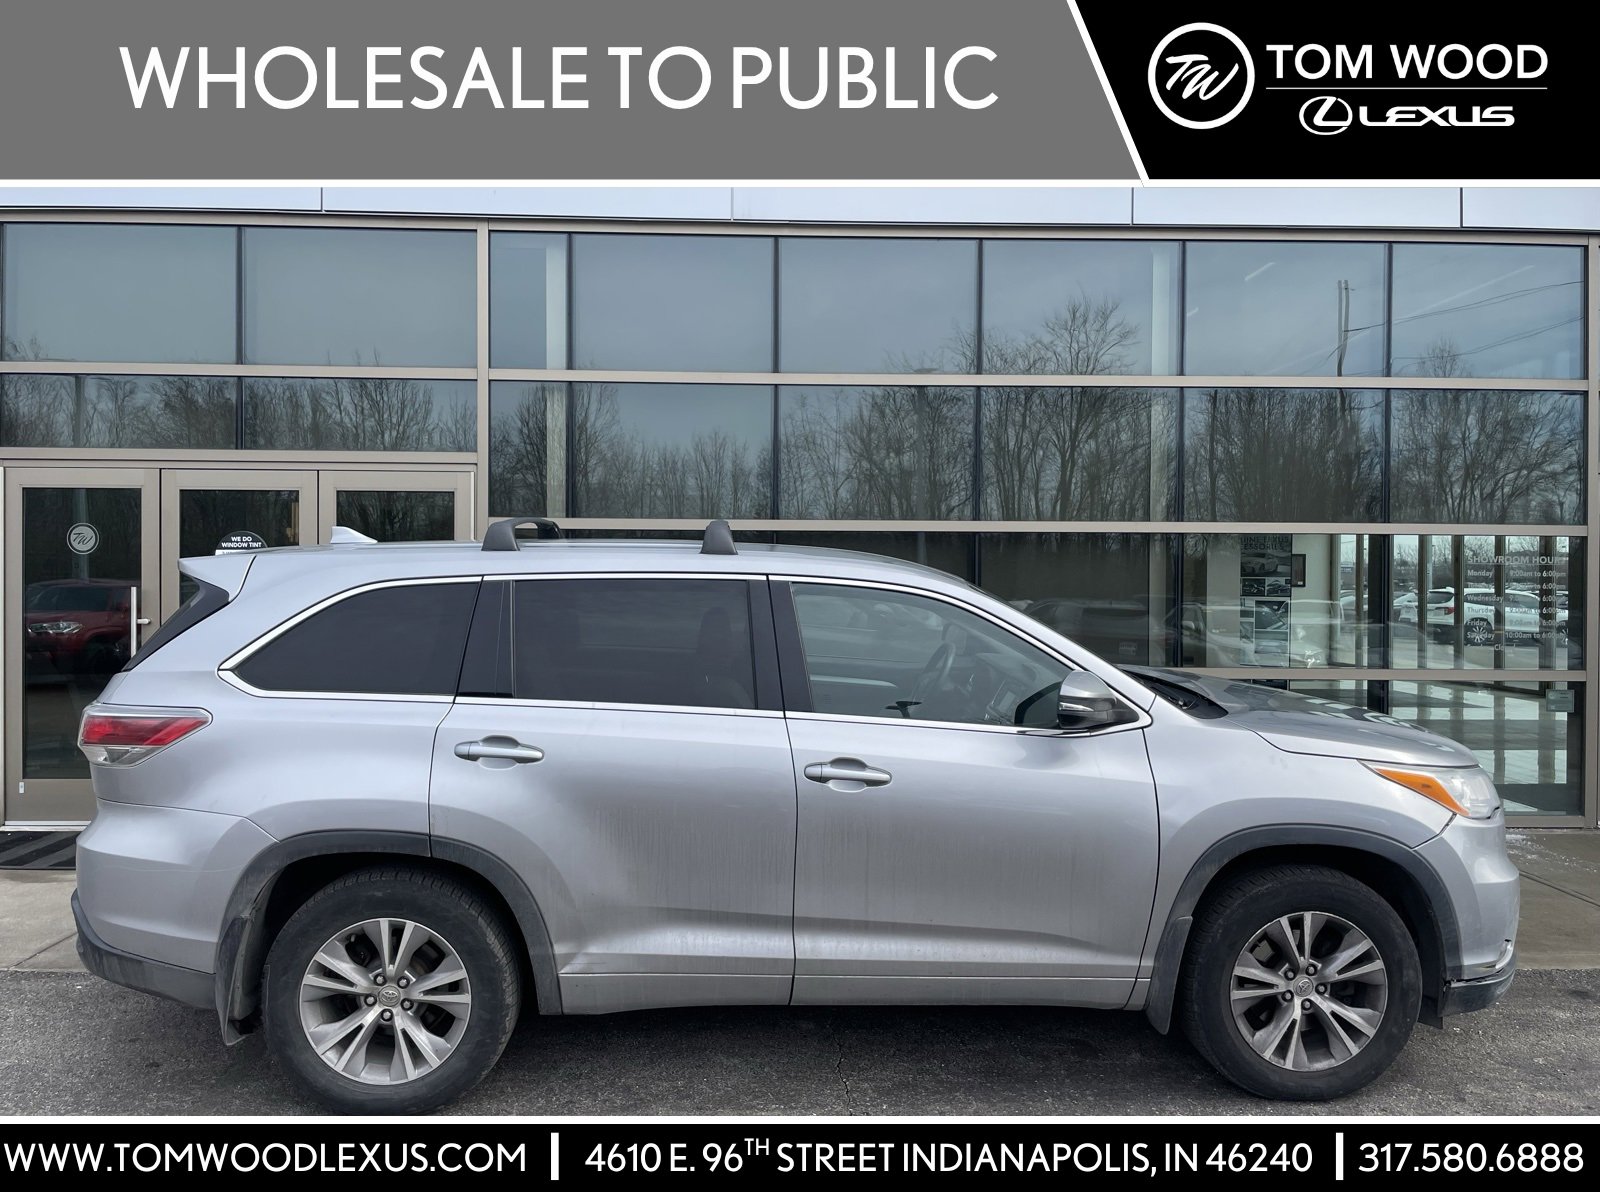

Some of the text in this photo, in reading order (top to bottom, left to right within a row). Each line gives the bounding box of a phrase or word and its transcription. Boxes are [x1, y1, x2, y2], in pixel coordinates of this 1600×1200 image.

[1467, 555, 1530, 564] SHOWROOM
[1467, 569, 1494, 578] Monday
[1542, 570, 1567, 579] 6:00pm
[1467, 595, 1503, 603] Wednesday
[1467, 619, 1488, 628] Friday
